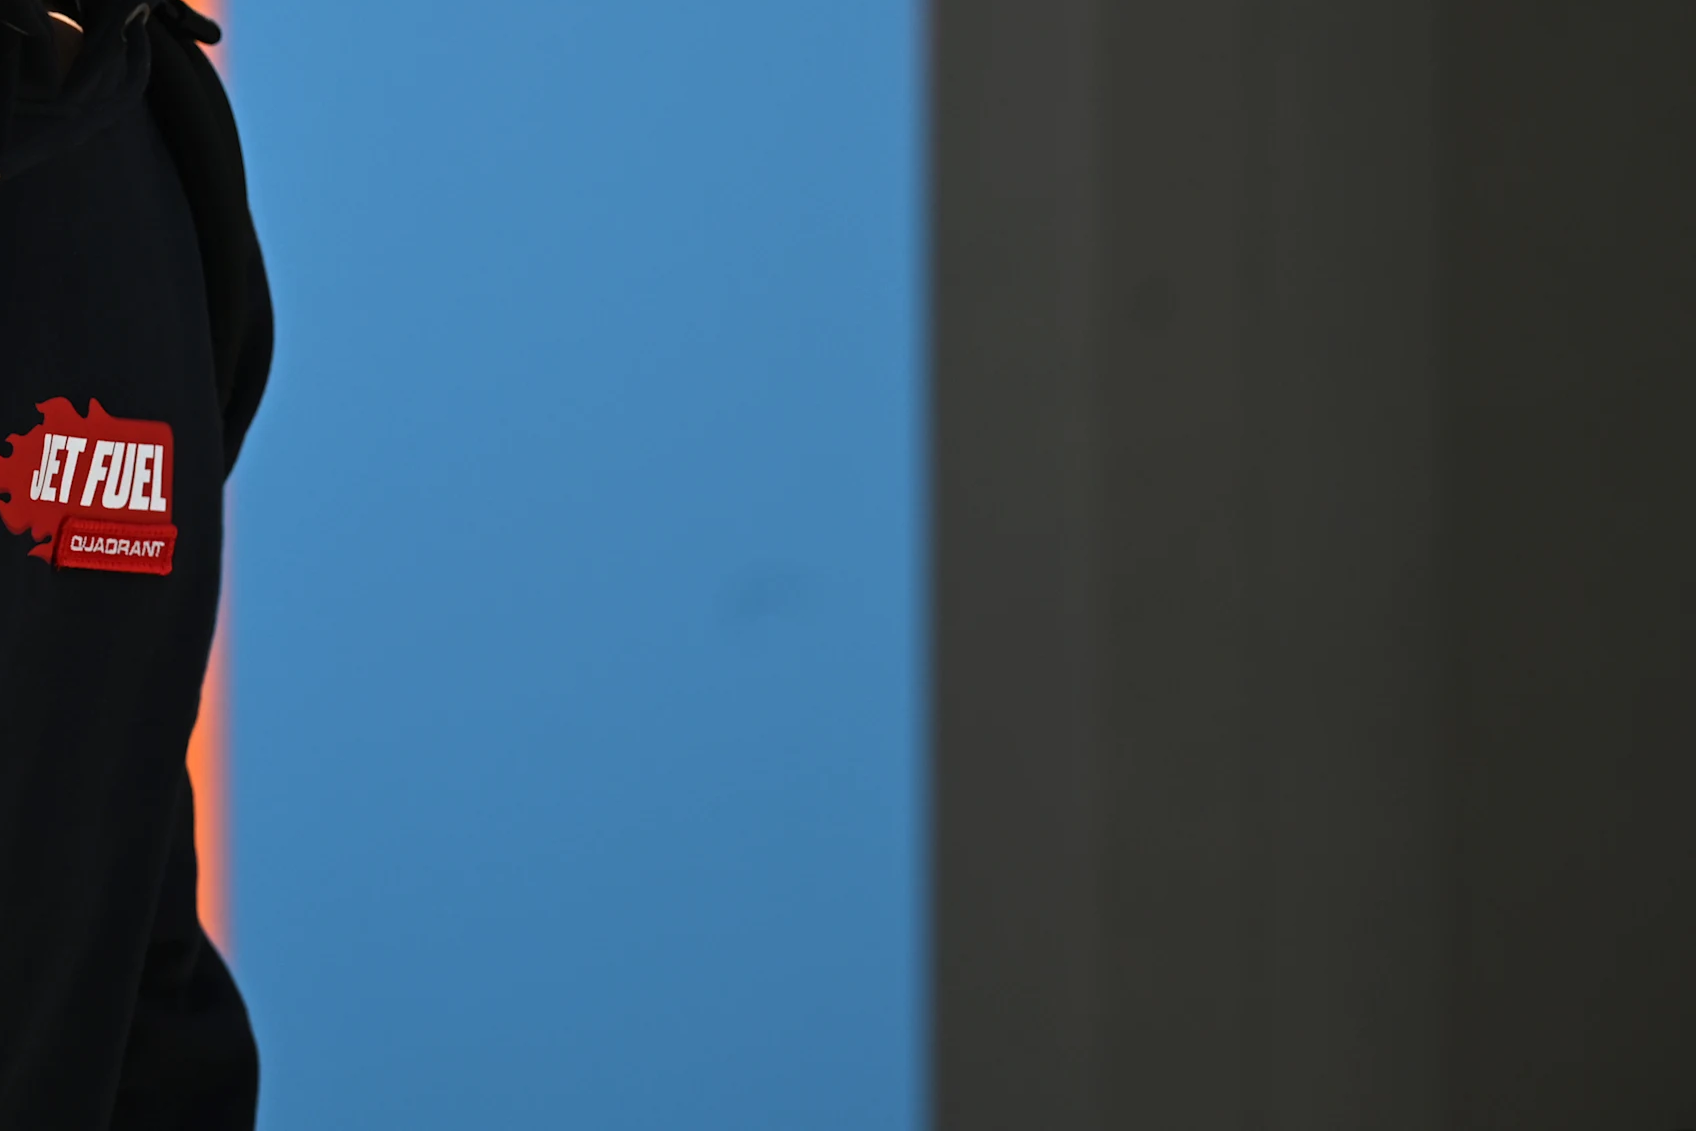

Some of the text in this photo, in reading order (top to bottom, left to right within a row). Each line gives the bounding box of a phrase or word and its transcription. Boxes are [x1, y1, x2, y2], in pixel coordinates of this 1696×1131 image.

[29, 433, 167, 512] JET FUEL
[70, 535, 165, 557] QUADRANT
